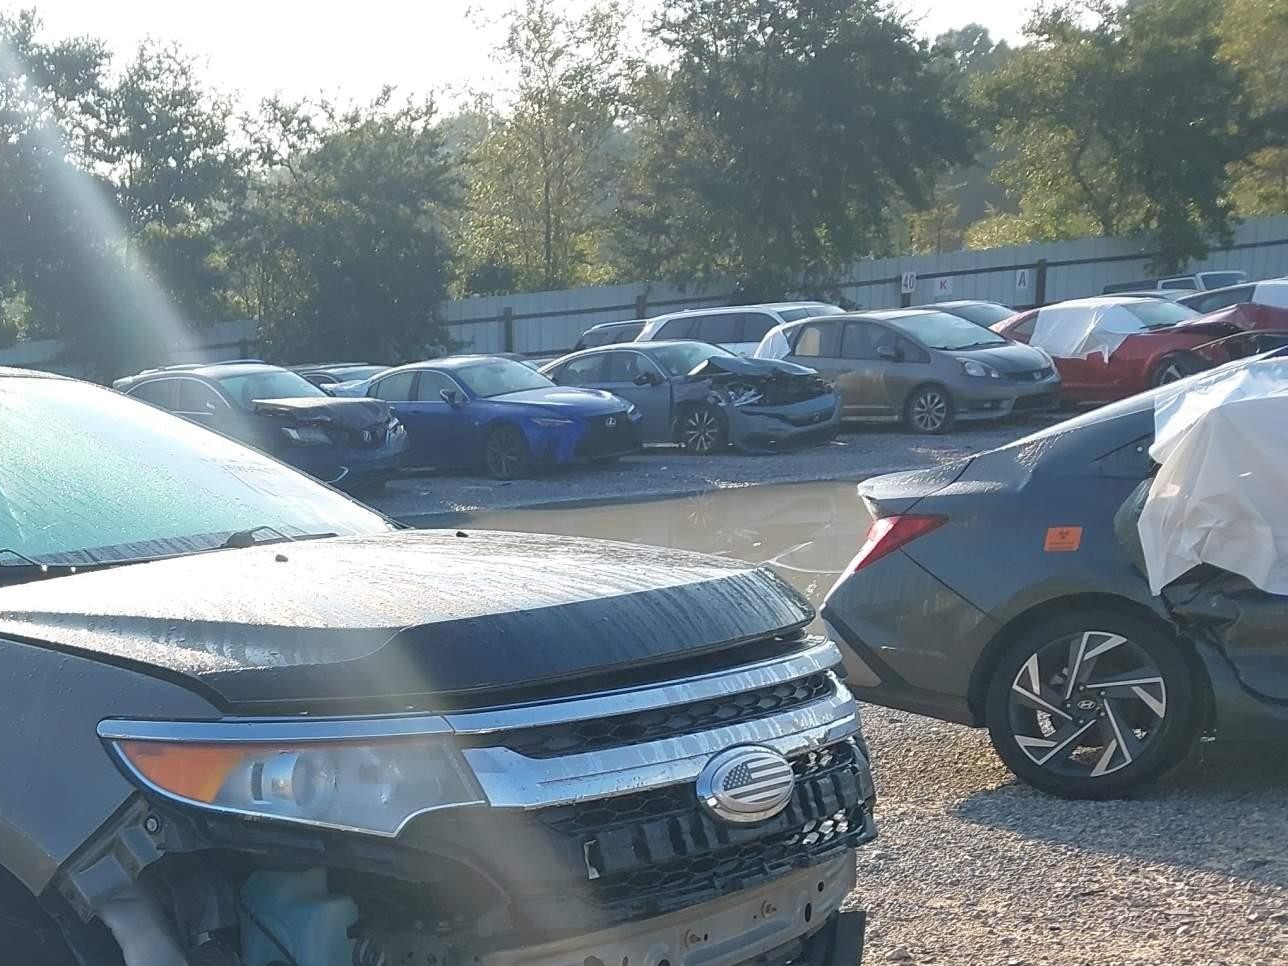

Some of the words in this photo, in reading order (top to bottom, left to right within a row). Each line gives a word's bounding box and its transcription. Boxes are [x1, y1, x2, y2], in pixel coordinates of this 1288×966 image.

[903, 273, 915, 290] 40
[939, 279, 948, 290] K
[1017, 271, 1027, 287] A
